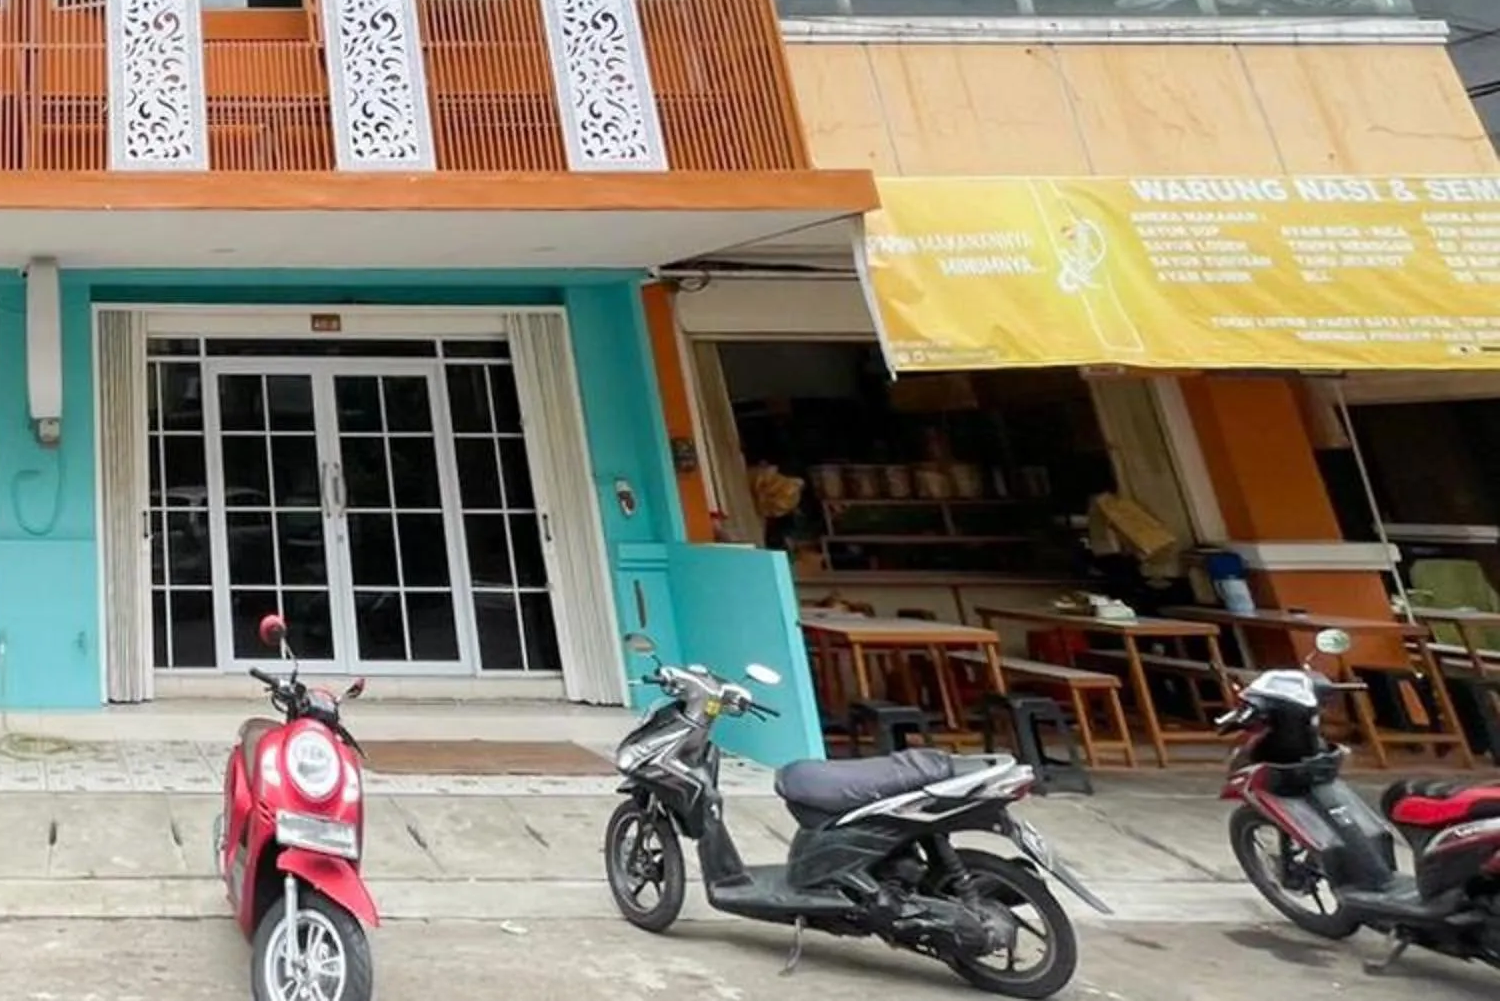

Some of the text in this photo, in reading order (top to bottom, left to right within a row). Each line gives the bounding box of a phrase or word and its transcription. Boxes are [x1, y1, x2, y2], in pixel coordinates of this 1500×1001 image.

[1130, 179, 1288, 202] WARUNG
[1293, 179, 1382, 202] NASI
[1389, 178, 1419, 203] &
